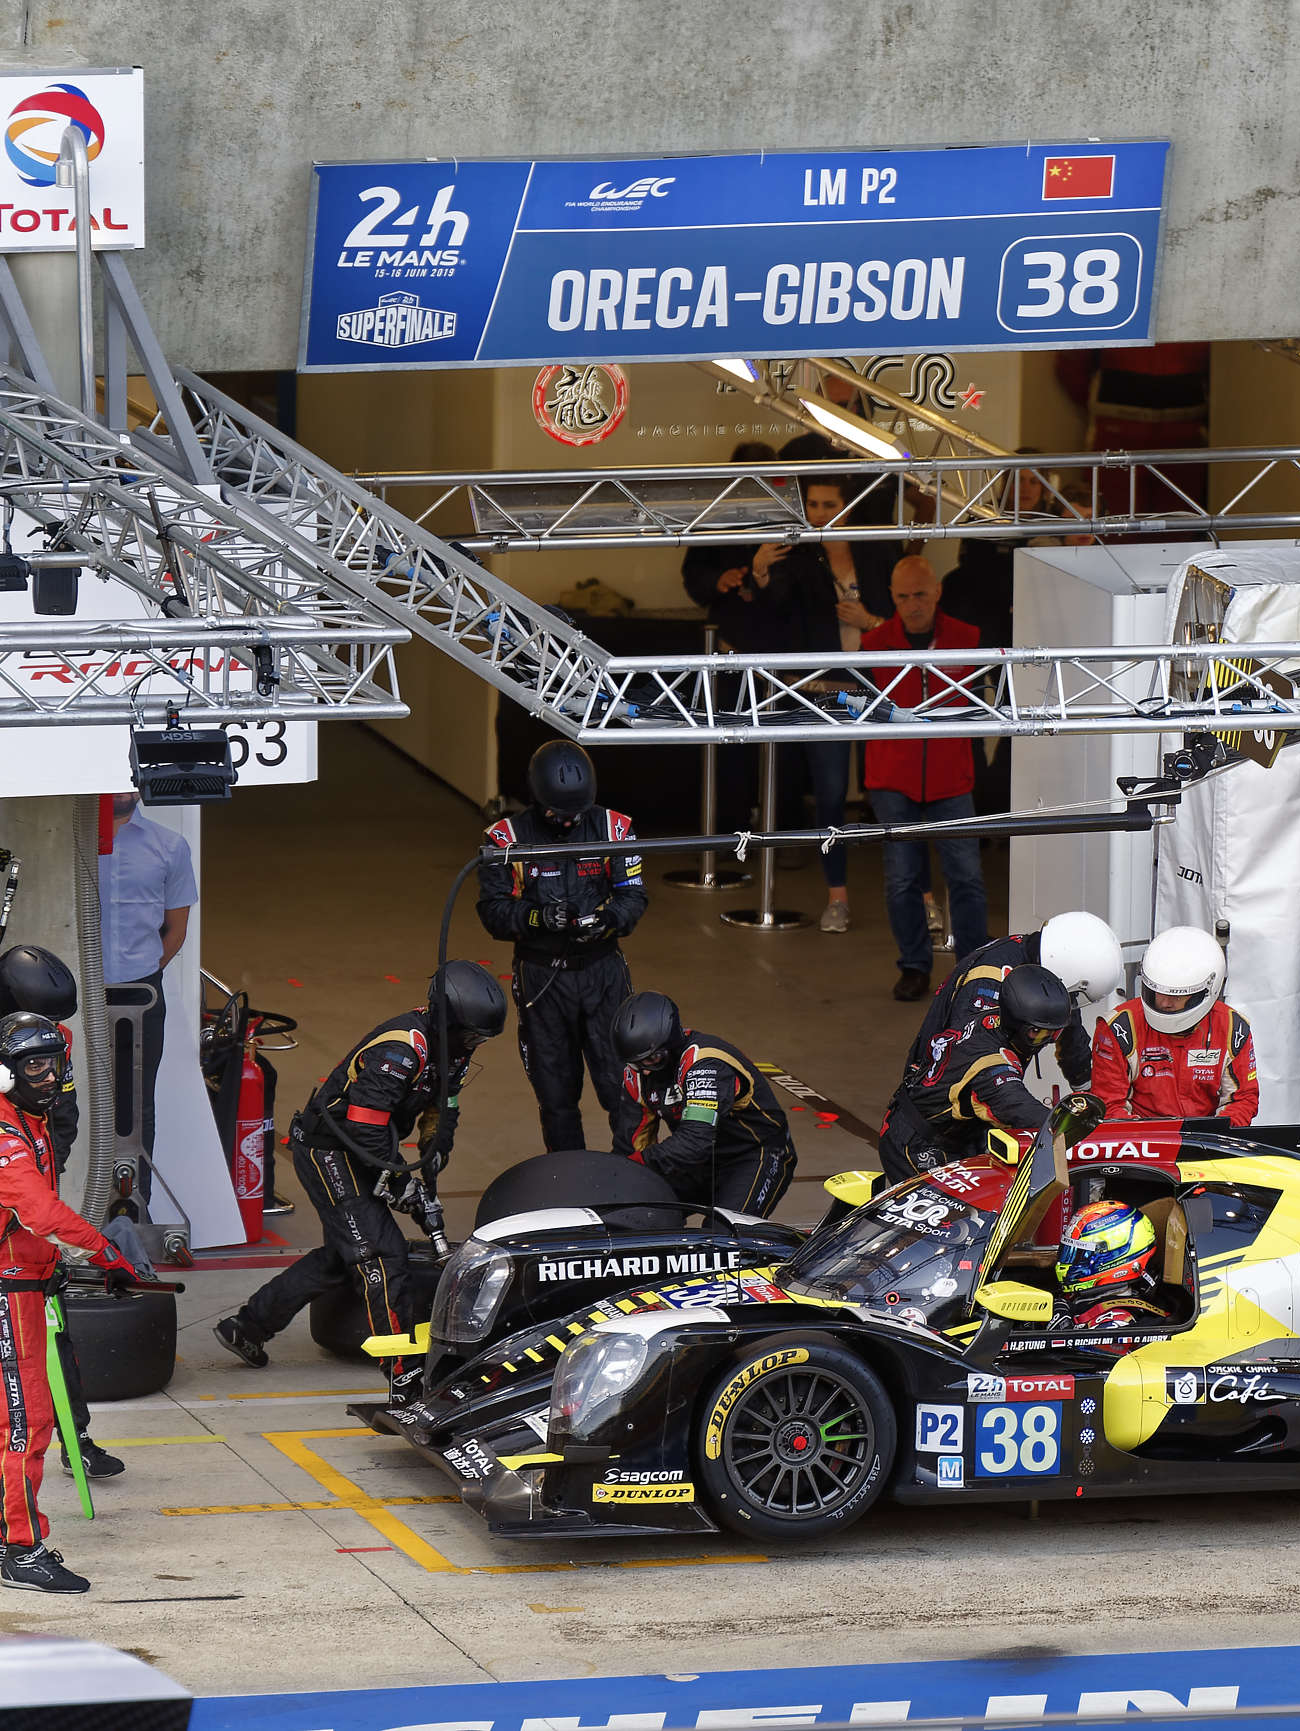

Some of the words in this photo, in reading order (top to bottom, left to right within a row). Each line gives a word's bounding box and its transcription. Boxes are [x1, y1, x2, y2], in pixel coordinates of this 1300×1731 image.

[588, 177, 676, 199] WEC
[803, 169, 848, 206] LM
[860, 168, 897, 205] P2
[337, 251, 374, 267] LE
[374, 268, 402, 278] 15-16
[405, 268, 428, 278] JUIN
[430, 268, 455, 278] 2019
[547, 256, 965, 333] ORECA-GIBSON
[1016, 249, 1121, 318] 38
[339, 306, 454, 345] SUPERFINALE
[938, 1197, 966, 1212] CHAN
[877, 1212, 914, 1229] JOTA
[915, 1223, 951, 1238] Sport
[538, 1256, 659, 1282] RICHARD
[666, 1251, 742, 1274] MILLE
[1208, 1366, 1242, 1374] JACKIE
[8, 1373, 20, 1407] JOTA
[712, 1350, 798, 1433] DUNLOP
[1008, 1379, 1071, 1392] TOTAL
[1209, 1374, 1287, 1404] Café
[920, 1412, 958, 1446] P2
[981, 1405, 1058, 1474] 38
[443, 1447, 480, 1479] 道达尔
[462, 1438, 493, 1476] TOTAL
[941, 1461, 960, 1479] M
[620, 1470, 683, 1485] sagcom
[611, 1489, 690, 1499] DUNLOP
